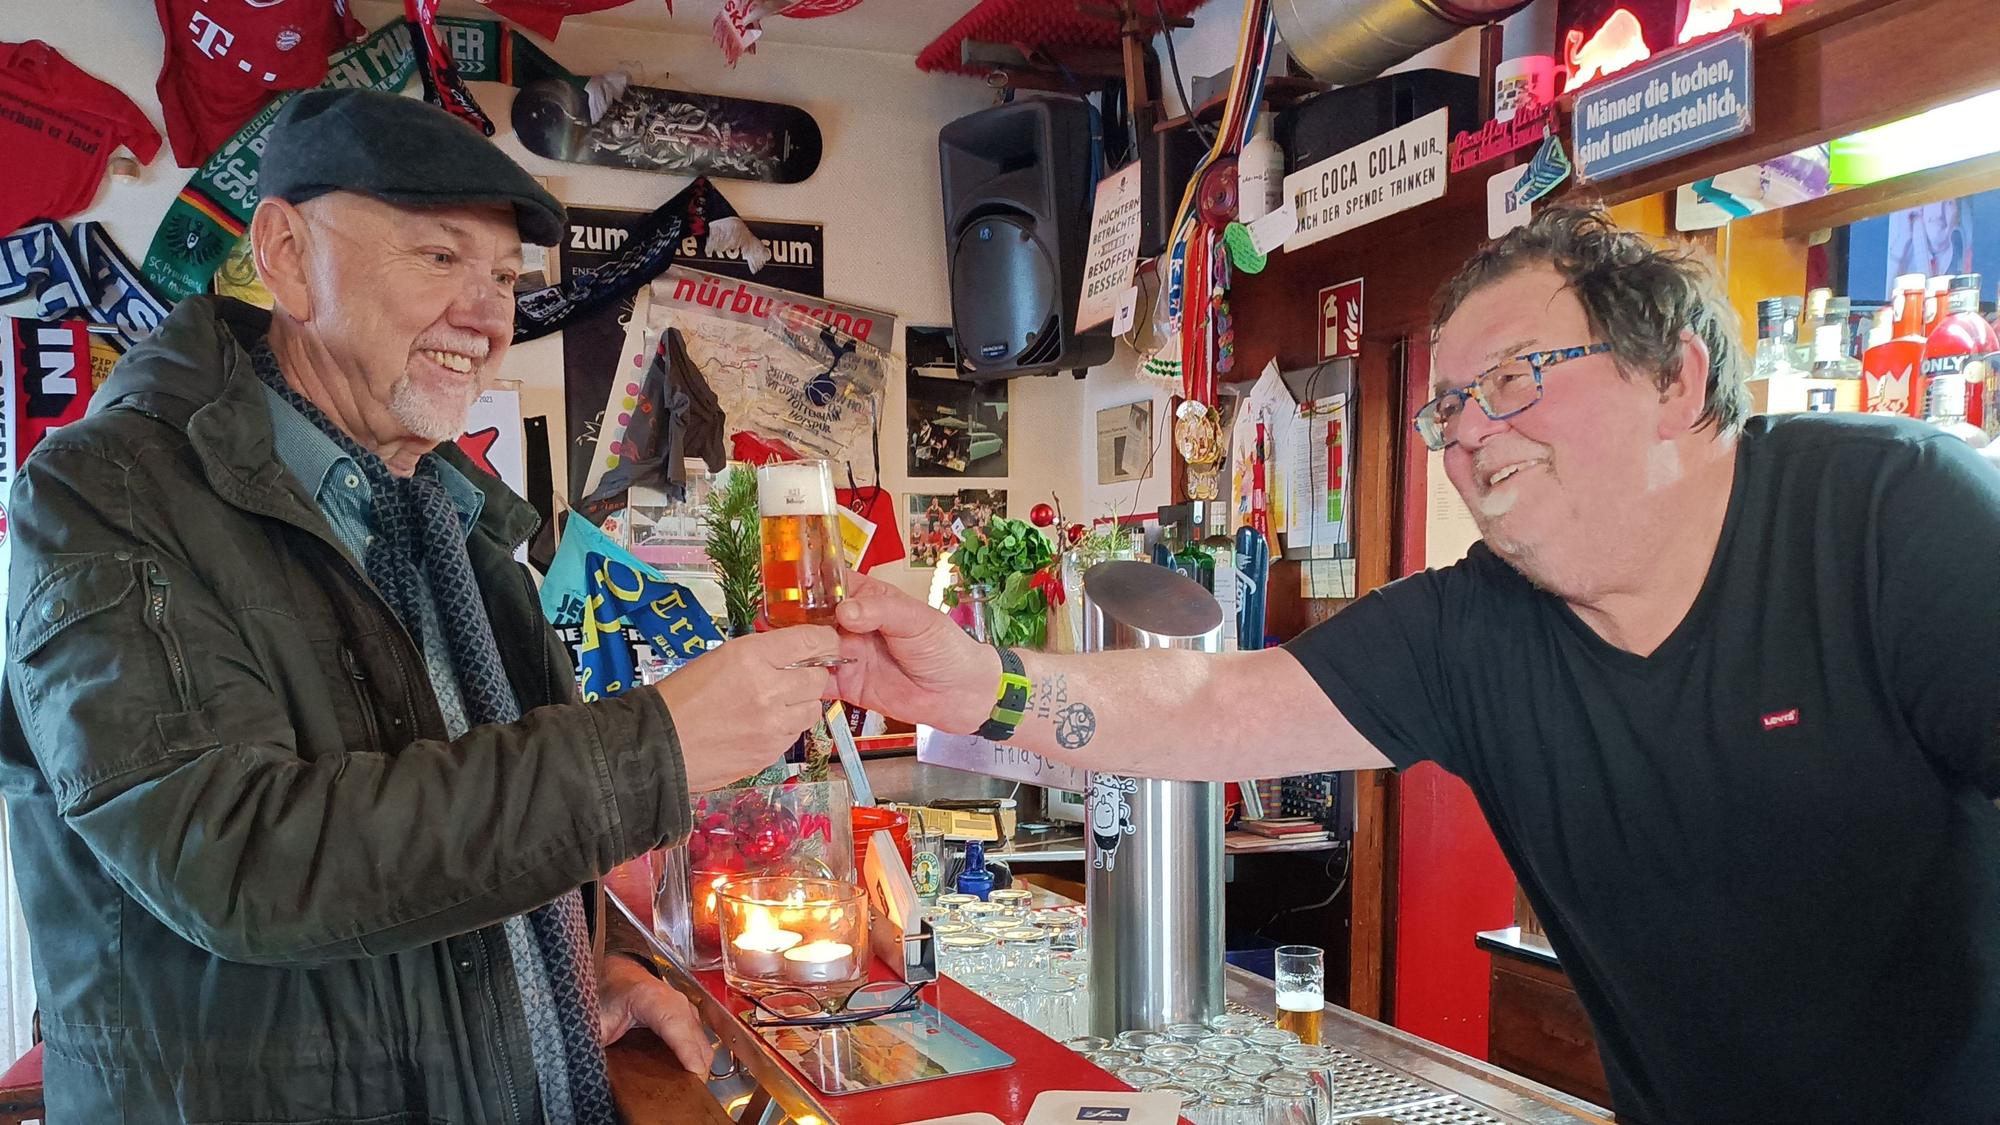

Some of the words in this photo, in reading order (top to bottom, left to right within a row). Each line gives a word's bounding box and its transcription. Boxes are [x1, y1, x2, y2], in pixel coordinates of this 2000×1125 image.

[1586, 91, 1642, 130] Männer
[1645, 78, 1669, 109] die
[1671, 59, 1734, 99] kochen,
[1580, 131, 1610, 164] sind
[1612, 87, 1743, 154] unwiderstehlich.
[1295, 187, 1318, 209] BITTE
[1322, 161, 1357, 198] COCA
[1369, 139, 1406, 178] COLA
[1322, 204, 1340, 224] DER
[1346, 186, 1384, 215] SPENDE
[1390, 166, 1435, 197] TRINKEN
[1093, 211, 1140, 245] BETRACHTET
[1098, 198, 1140, 228] NÜCHTERN
[571, 225, 629, 251] zum
[1088, 247, 1135, 279] BESOFFEN
[1087, 266, 1128, 299] BESSER!
[787, 395, 841, 421] TOTTENHAM
[788, 409, 832, 434] HOTSPUR
